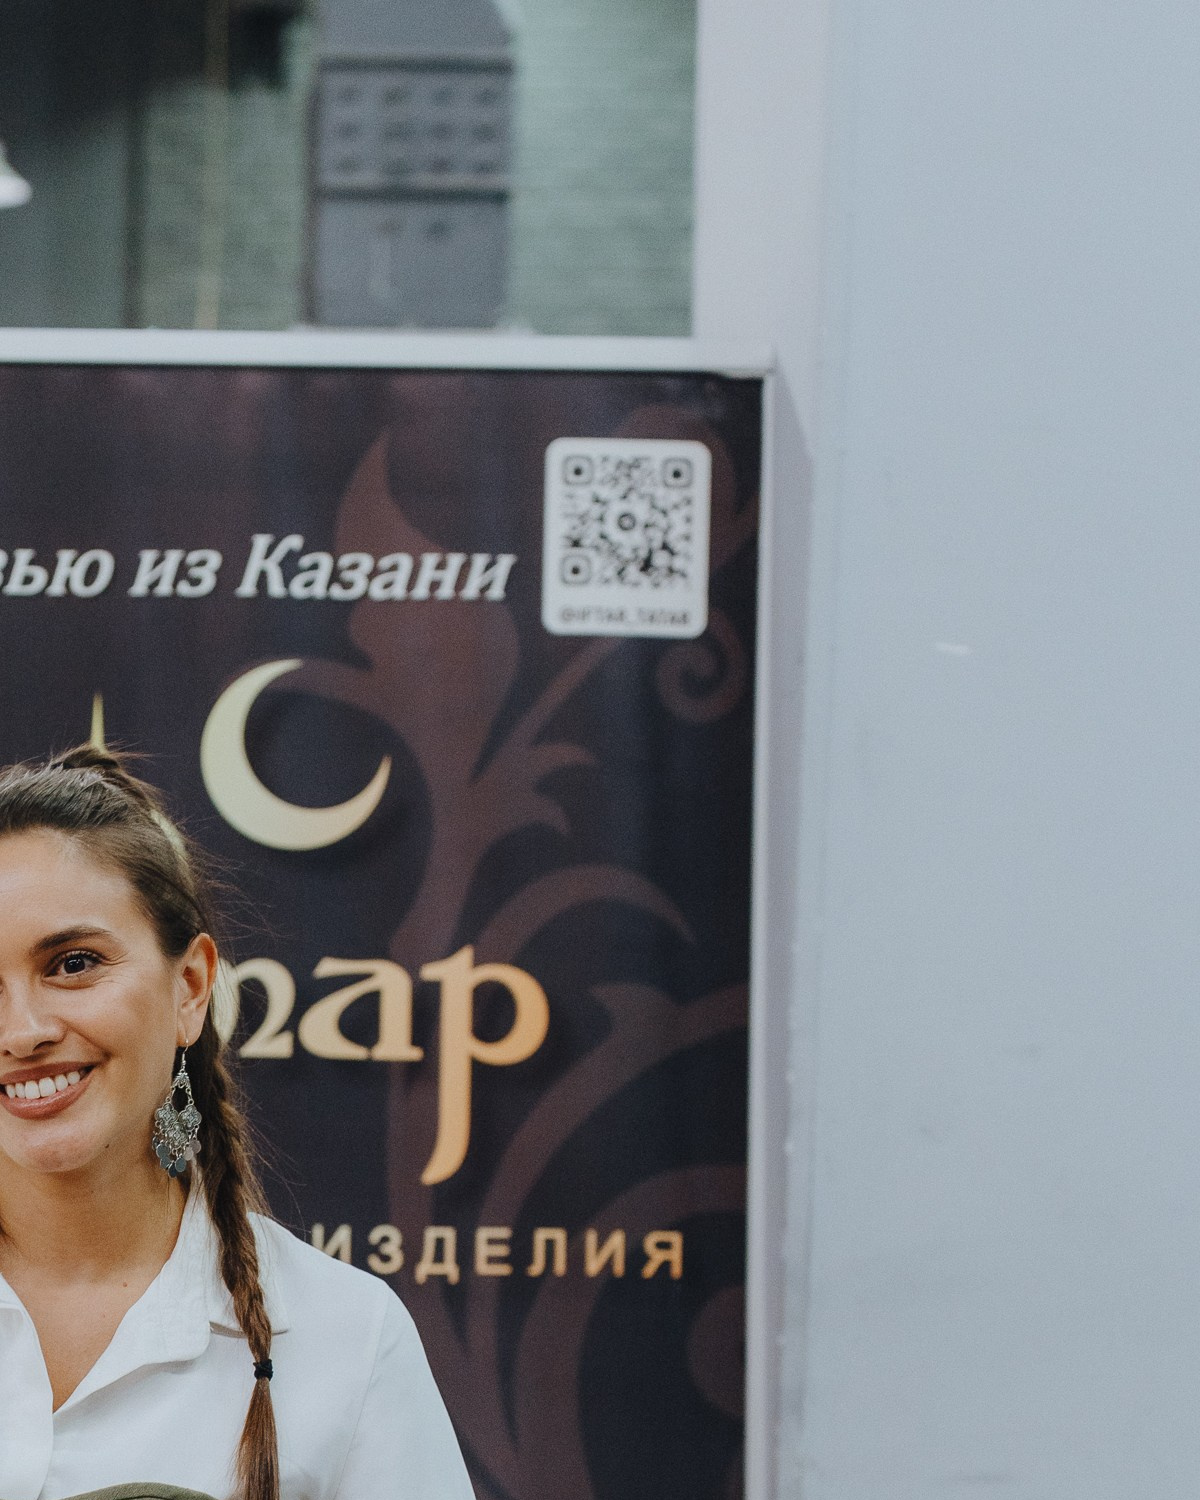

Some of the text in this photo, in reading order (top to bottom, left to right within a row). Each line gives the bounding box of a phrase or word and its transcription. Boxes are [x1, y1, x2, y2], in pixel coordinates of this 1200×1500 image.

[126, 549, 223, 599] из
[234, 533, 518, 600] Казани
[311, 1223, 684, 1286] ИЗДЕЛИЯ
